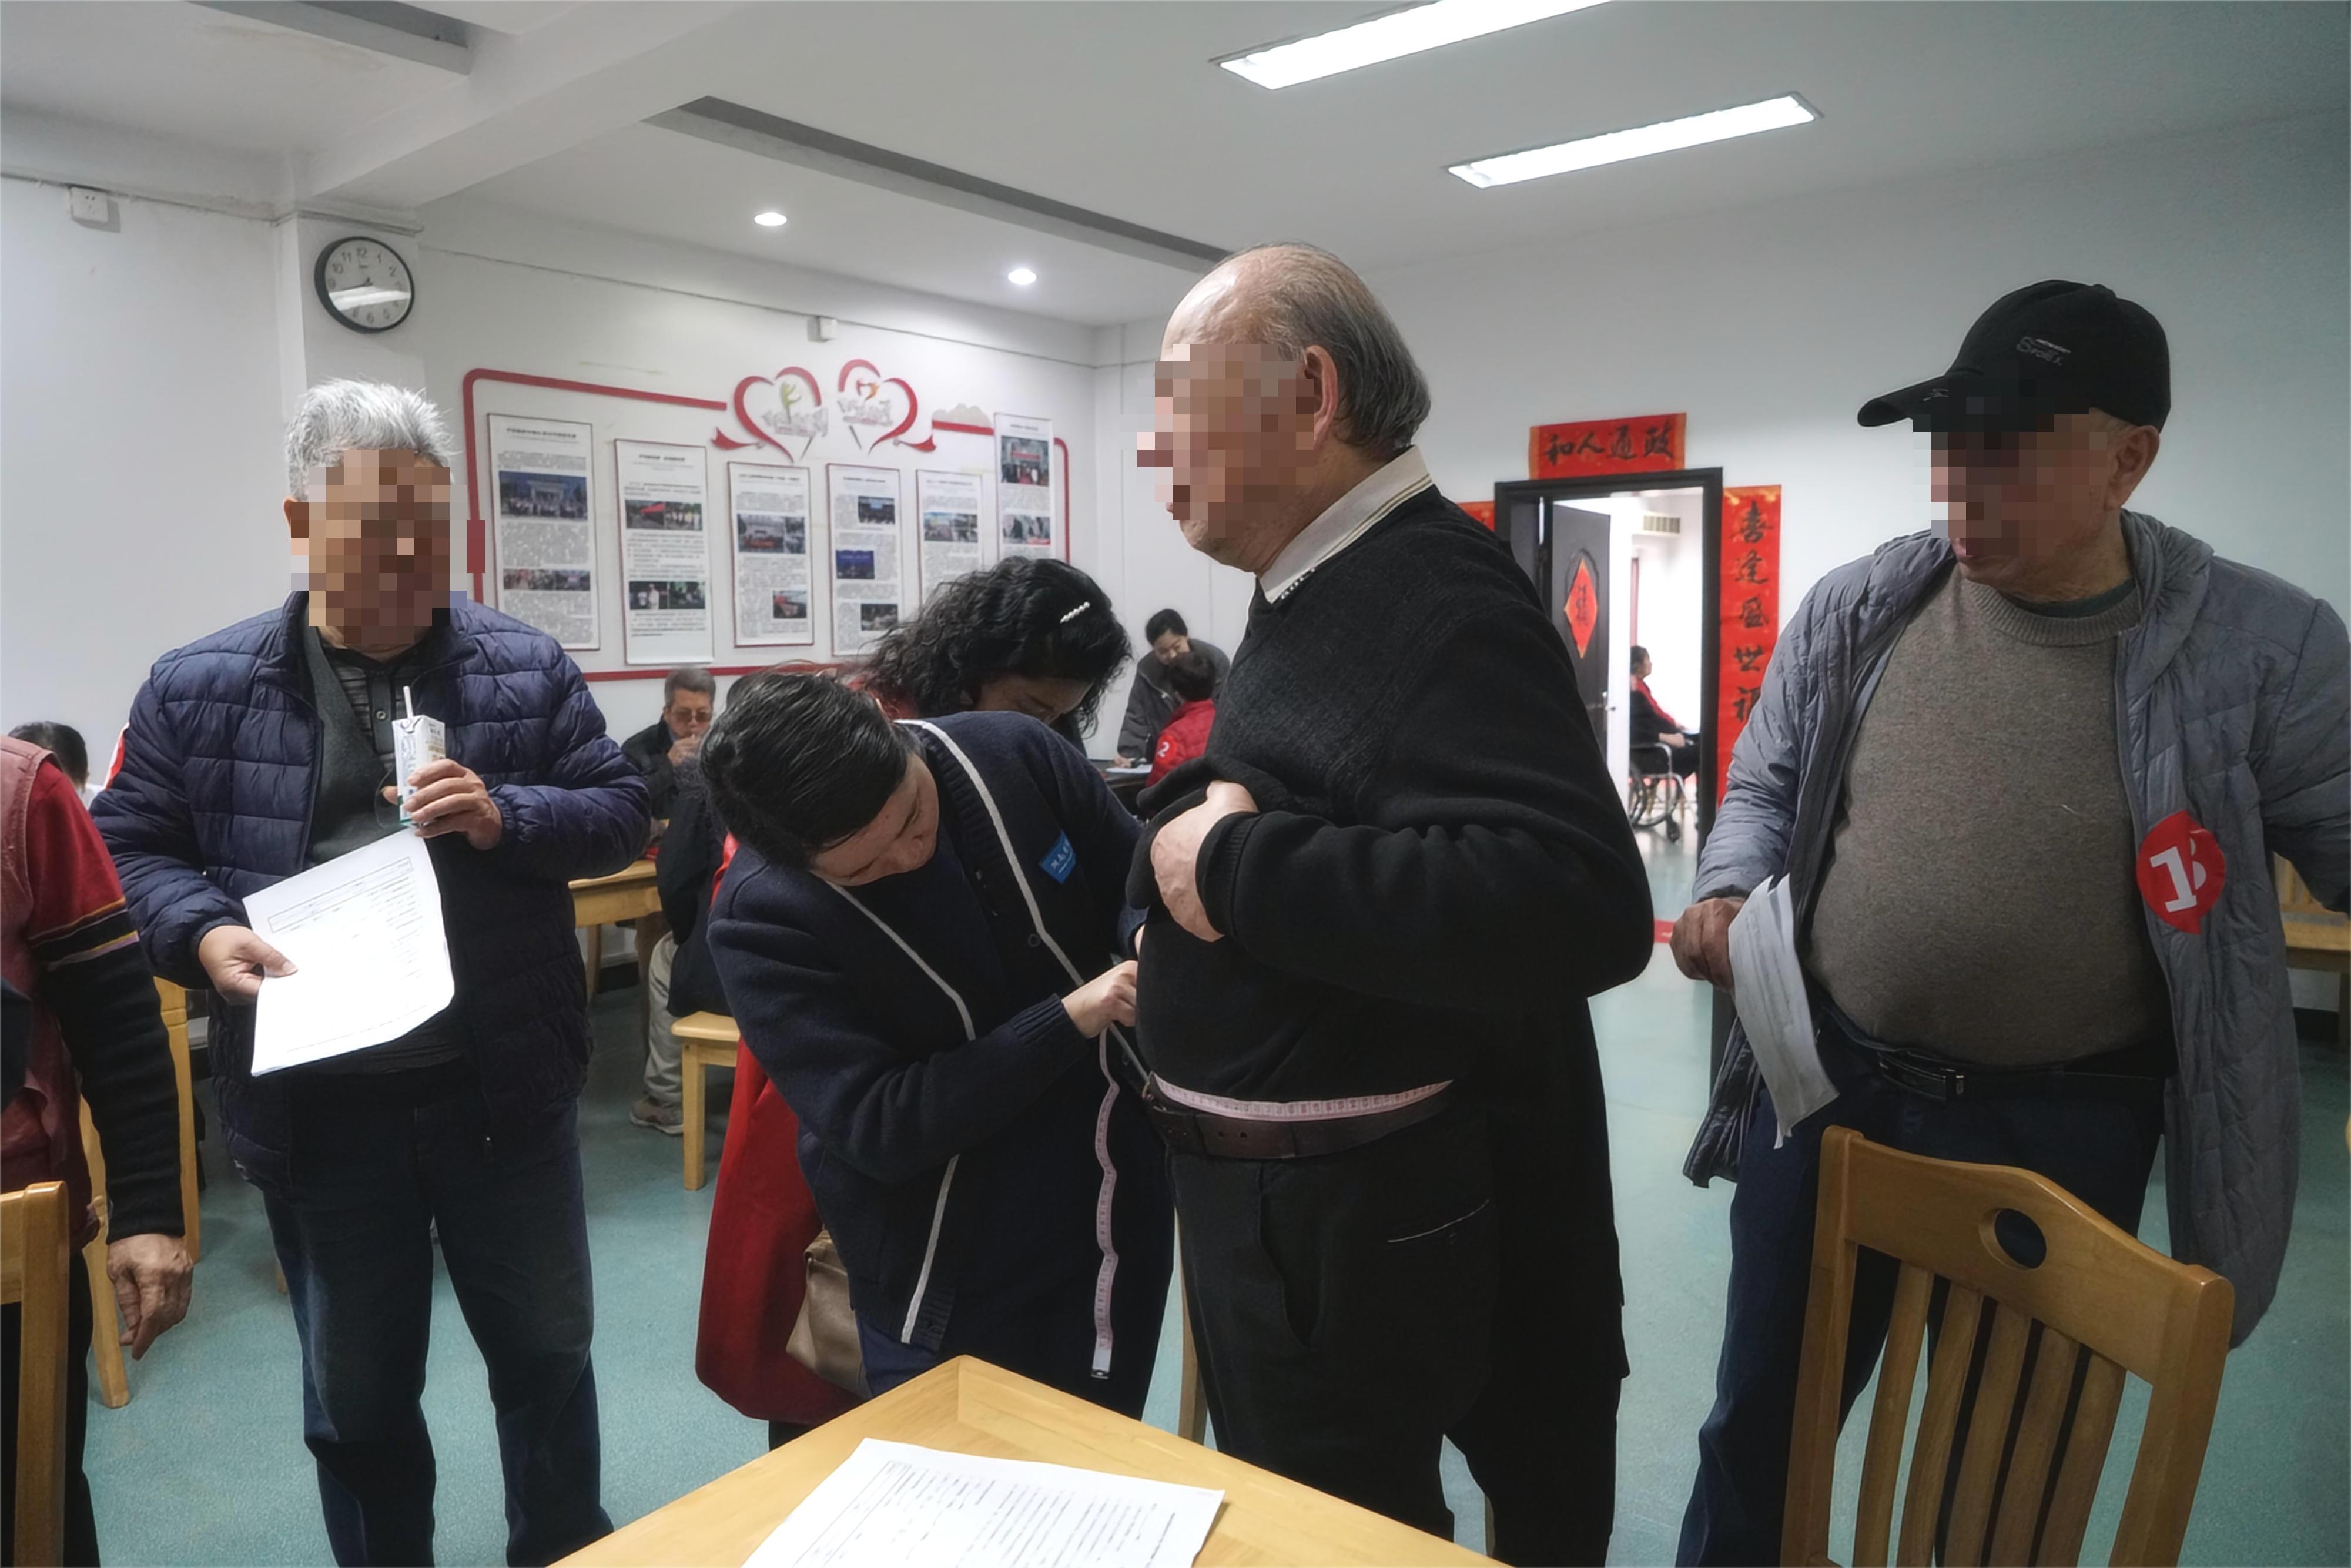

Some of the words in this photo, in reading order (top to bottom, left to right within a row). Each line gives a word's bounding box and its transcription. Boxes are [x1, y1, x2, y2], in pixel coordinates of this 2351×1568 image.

[357, 247, 367, 259] 12
[389, 266, 397, 277] 2
[1158, 741, 1170, 758] 2
